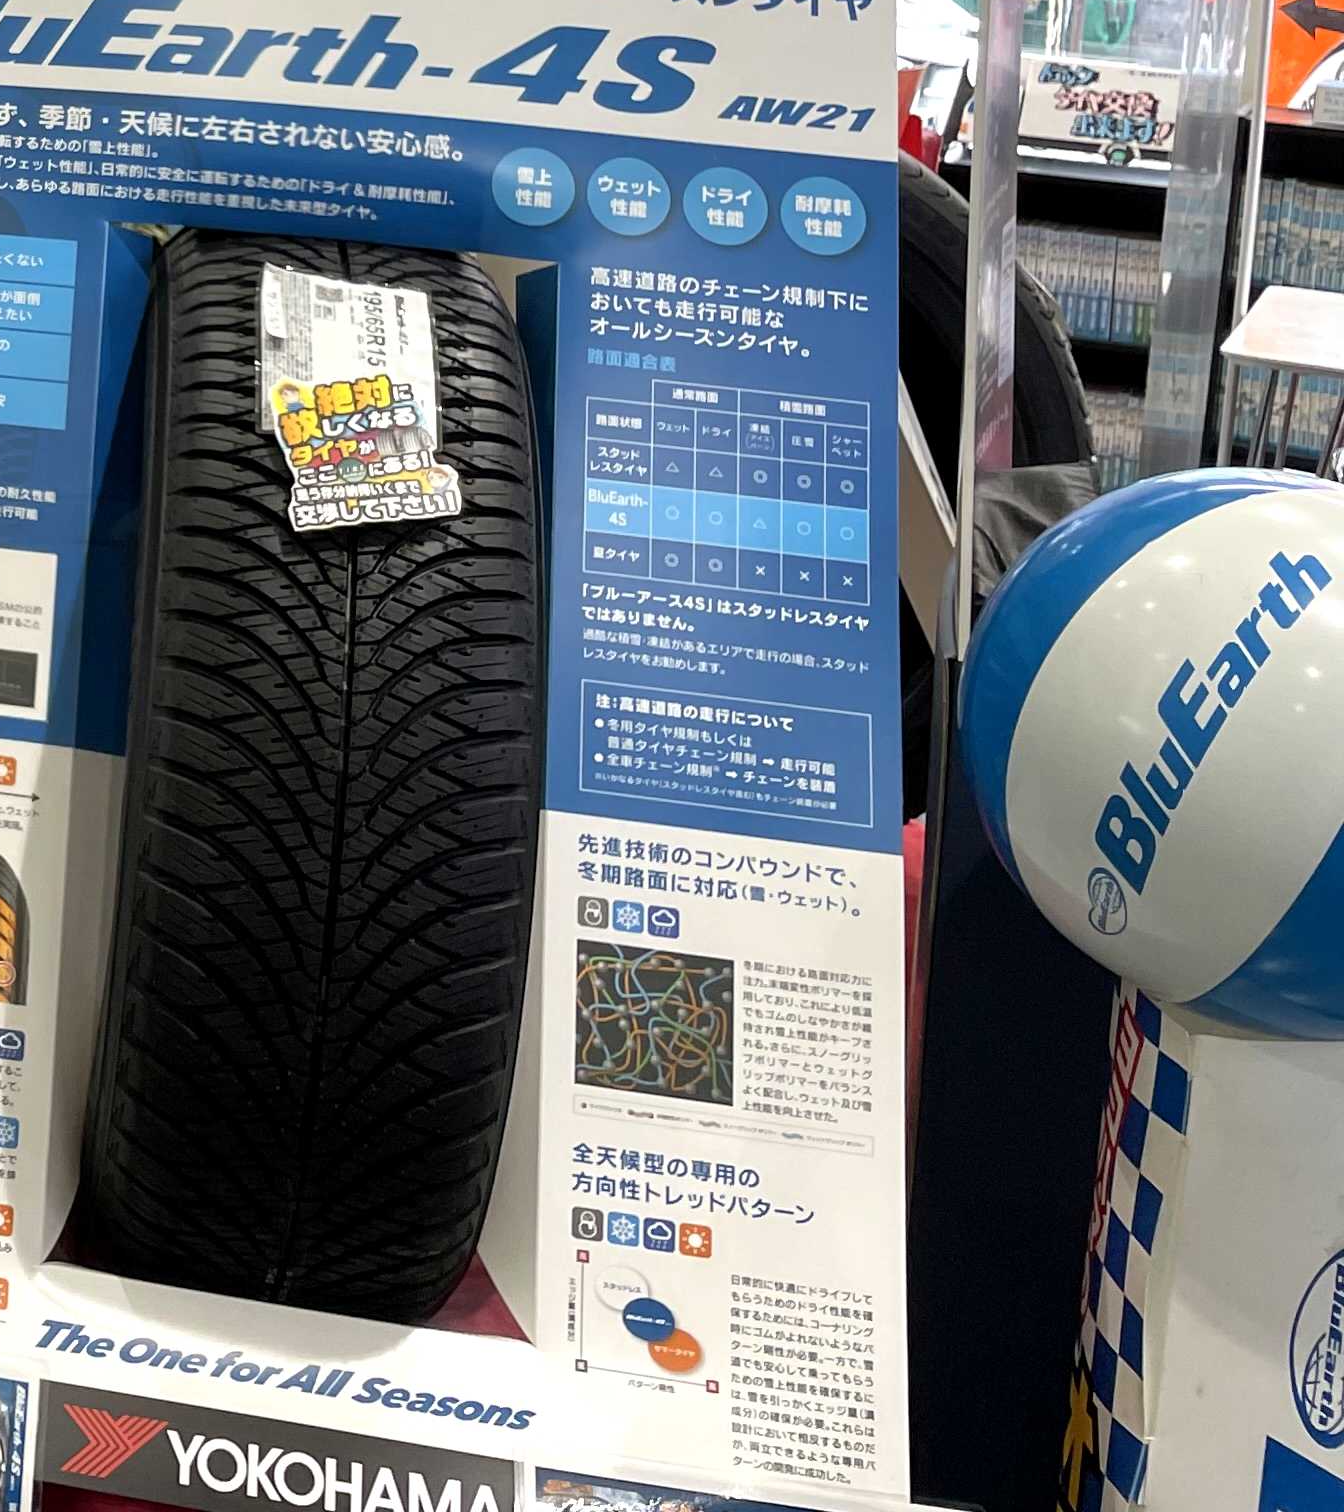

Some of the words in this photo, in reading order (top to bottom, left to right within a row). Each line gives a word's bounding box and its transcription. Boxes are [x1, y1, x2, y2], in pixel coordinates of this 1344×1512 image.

[718, 94, 878, 133] AW21
[597, 175, 662, 199] ウェット
[700, 186, 753, 208] ドライ
[590, 266, 869, 313] 高速道路のチェーン規制下に
[590, 291, 785, 329] おいても走行可能な
[589, 317, 812, 359] オールシーズンタイヤ。
[314, 374, 414, 417] 絶対に
[608, 511, 627, 527] 4S
[581, 606, 696, 633] ではありません。
[1094, 550, 1333, 896] BluEarth
[577, 833, 859, 889] 先進技術のコンパウンドで、
[571, 1142, 761, 1189] 全天候型の専用の
[571, 1170, 815, 1225] 方向性トレッドパターン
[34, 1318, 117, 1360] The
[118, 1336, 215, 1376] One
[209, 1349, 283, 1387] for
[278, 1363, 356, 1400] All
[351, 1375, 539, 1432] Seasons
[165, 1428, 507, 1512] YOKOHAMA
